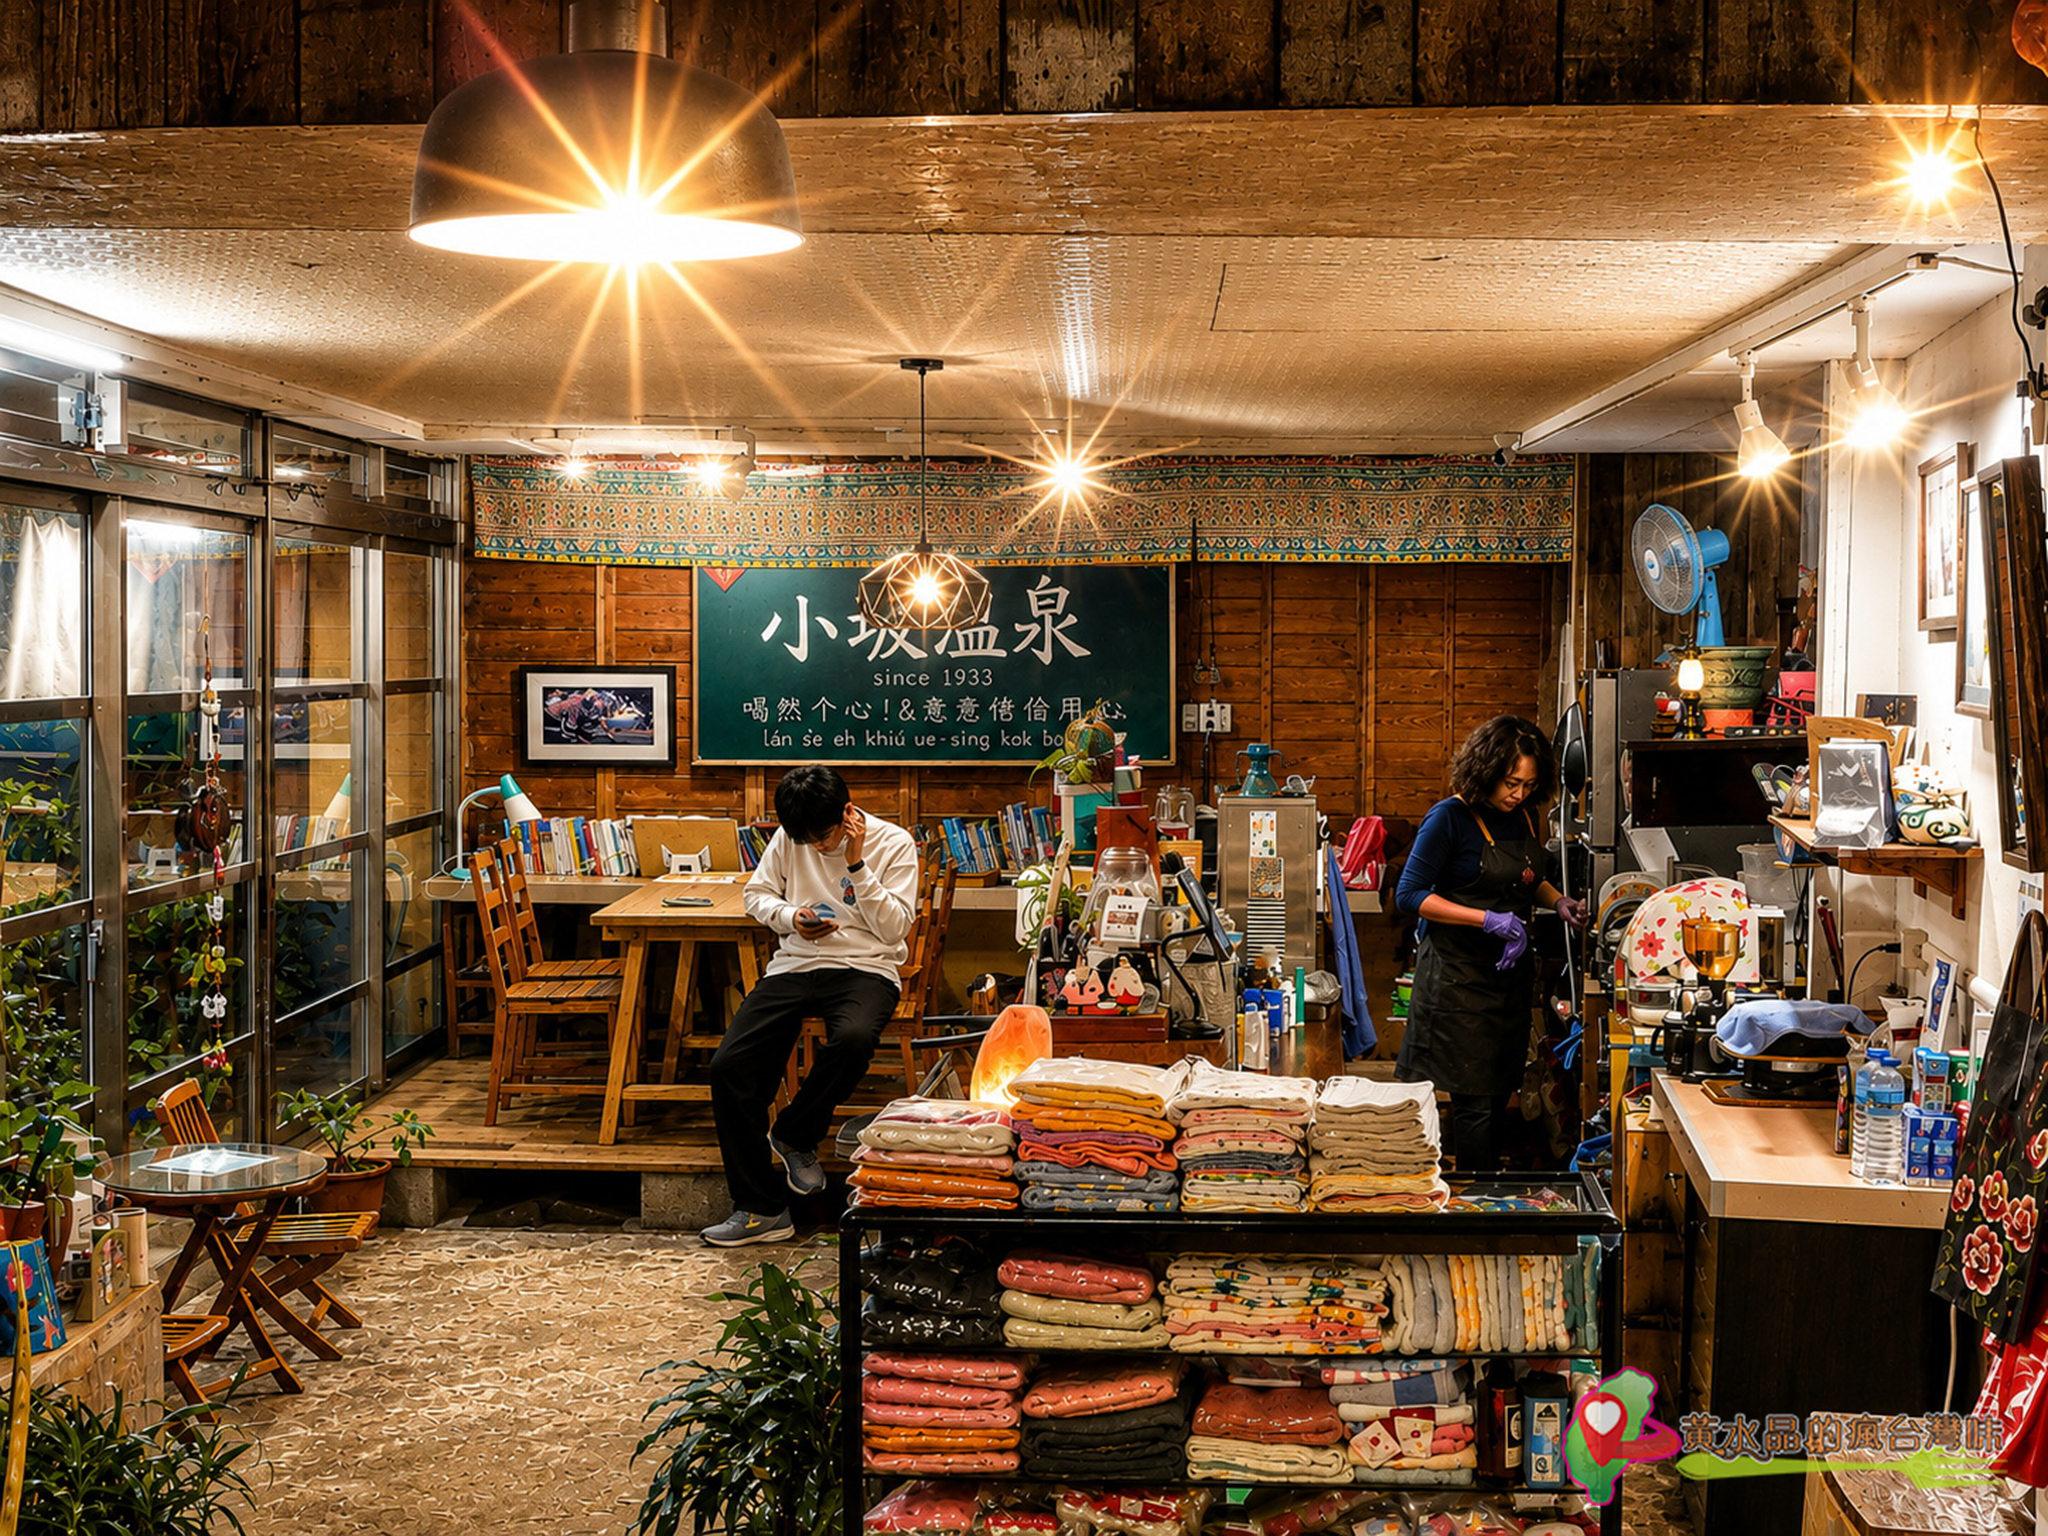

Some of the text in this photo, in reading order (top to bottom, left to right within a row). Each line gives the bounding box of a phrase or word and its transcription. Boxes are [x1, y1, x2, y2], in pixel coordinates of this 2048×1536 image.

[873, 669, 993, 687] since 1933
[764, 729, 792, 747] lán
[834, 729, 855, 747] eh
[866, 730, 905, 746] khiú
[1001, 730, 1032, 746] kok
